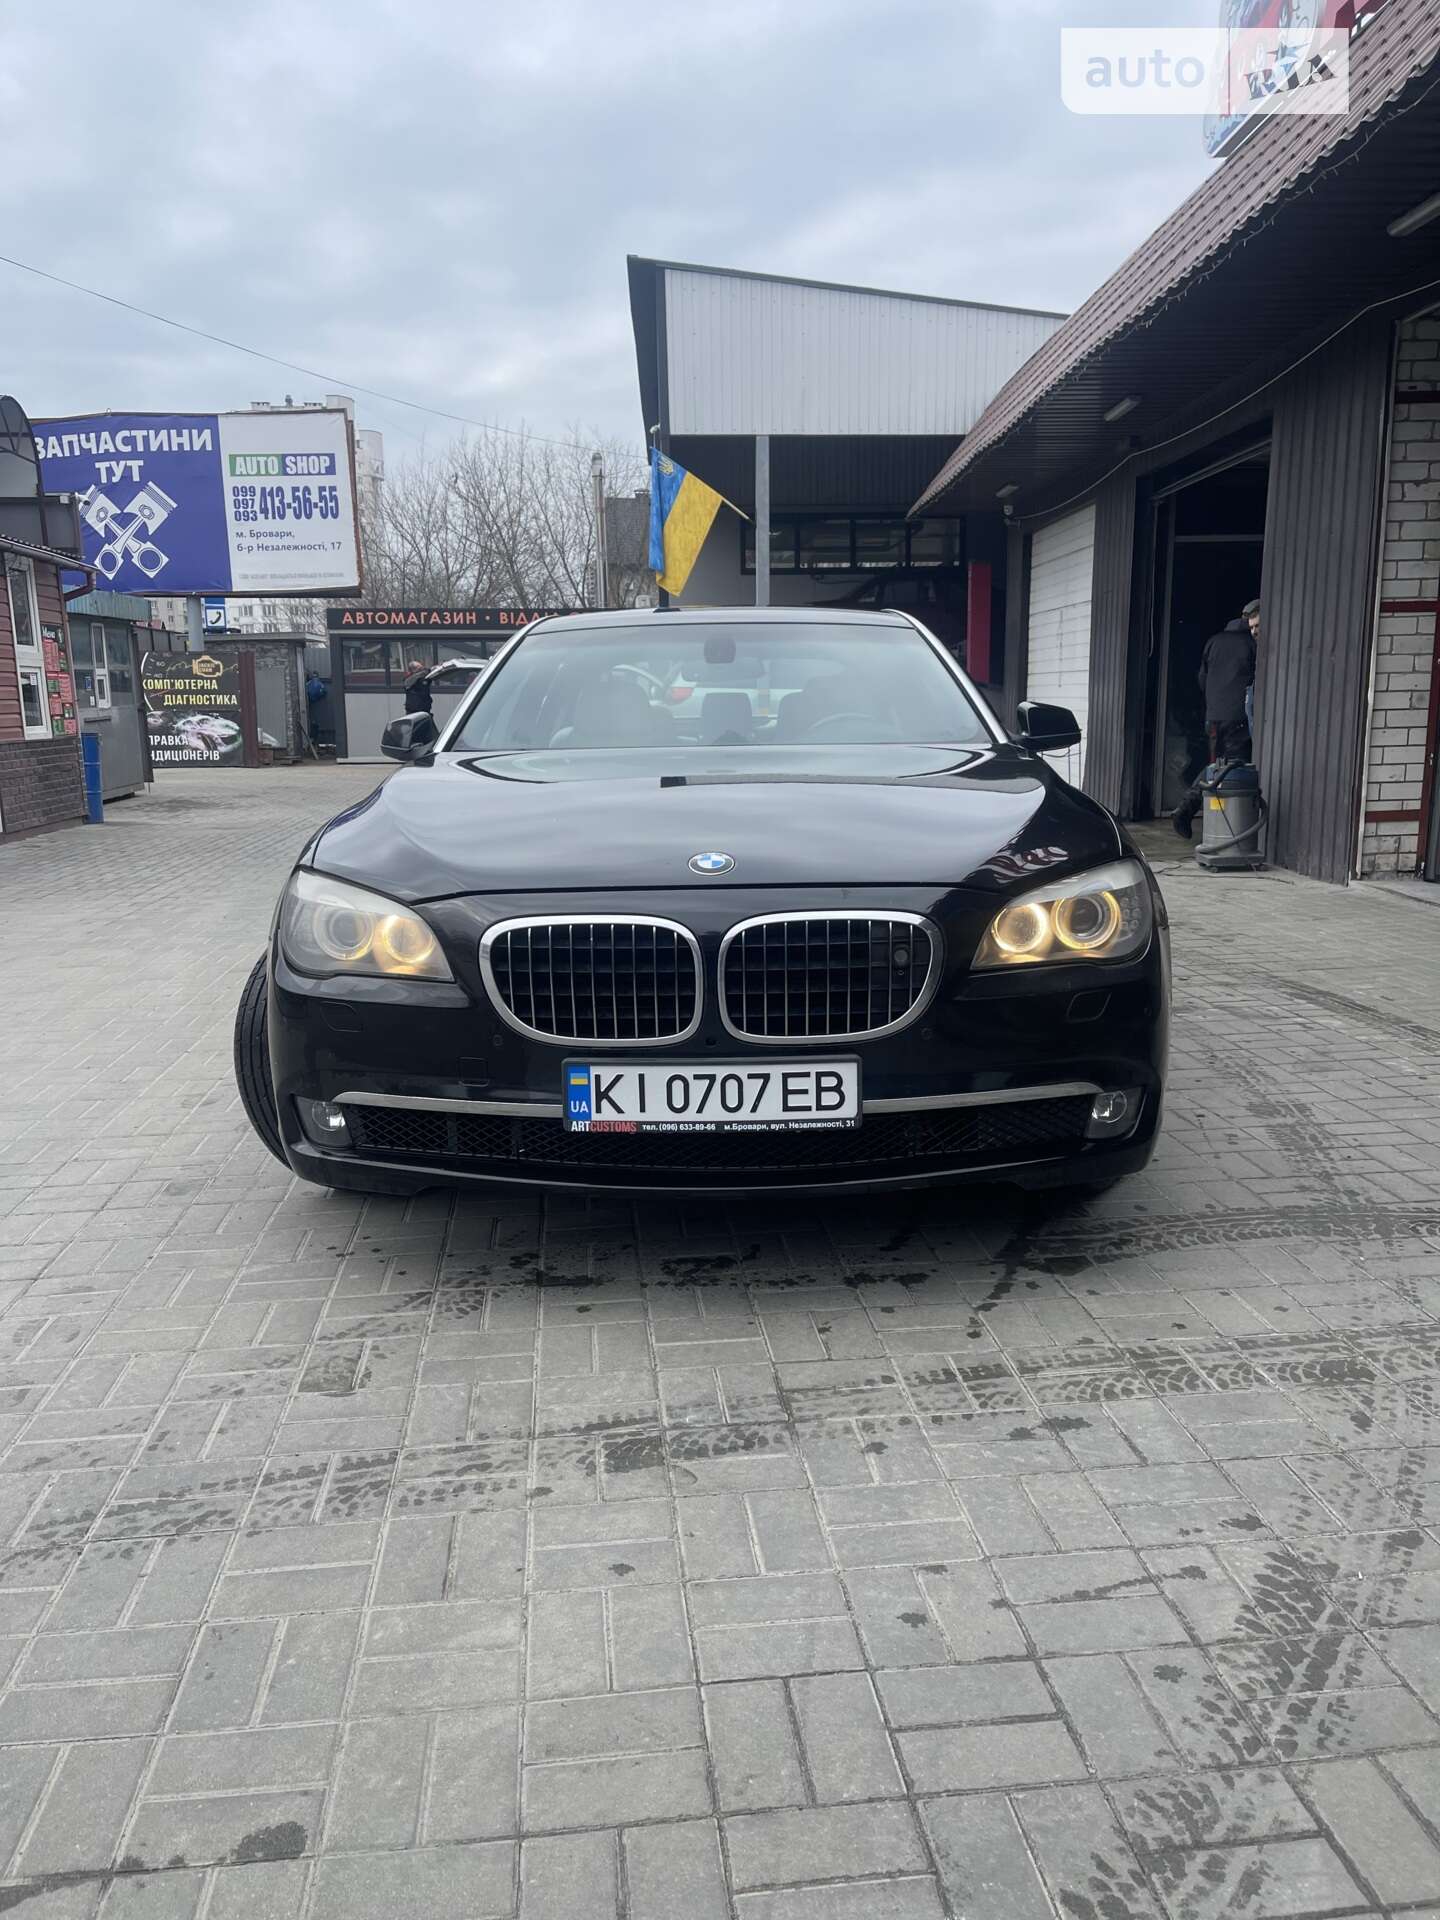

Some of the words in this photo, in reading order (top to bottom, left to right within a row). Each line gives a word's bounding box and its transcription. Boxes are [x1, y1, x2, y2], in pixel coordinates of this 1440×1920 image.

[34, 429, 213, 460] ЗАПЧАСТИНИ
[235, 456, 279, 475] AUTO
[285, 455, 330, 475] SHOP
[95, 460, 144, 484] ТУТ
[232, 485, 256, 498] 099
[233, 498, 255, 510] 097
[259, 485, 339, 520] 413-56-55
[234, 510, 258, 521] 093
[331, 541, 343, 551] 17
[341, 611, 477, 626] АВТОМАГАЗИН
[163, 694, 238, 706] ДІАГНОСТИКА
[570, 1100, 589, 1113] UA
